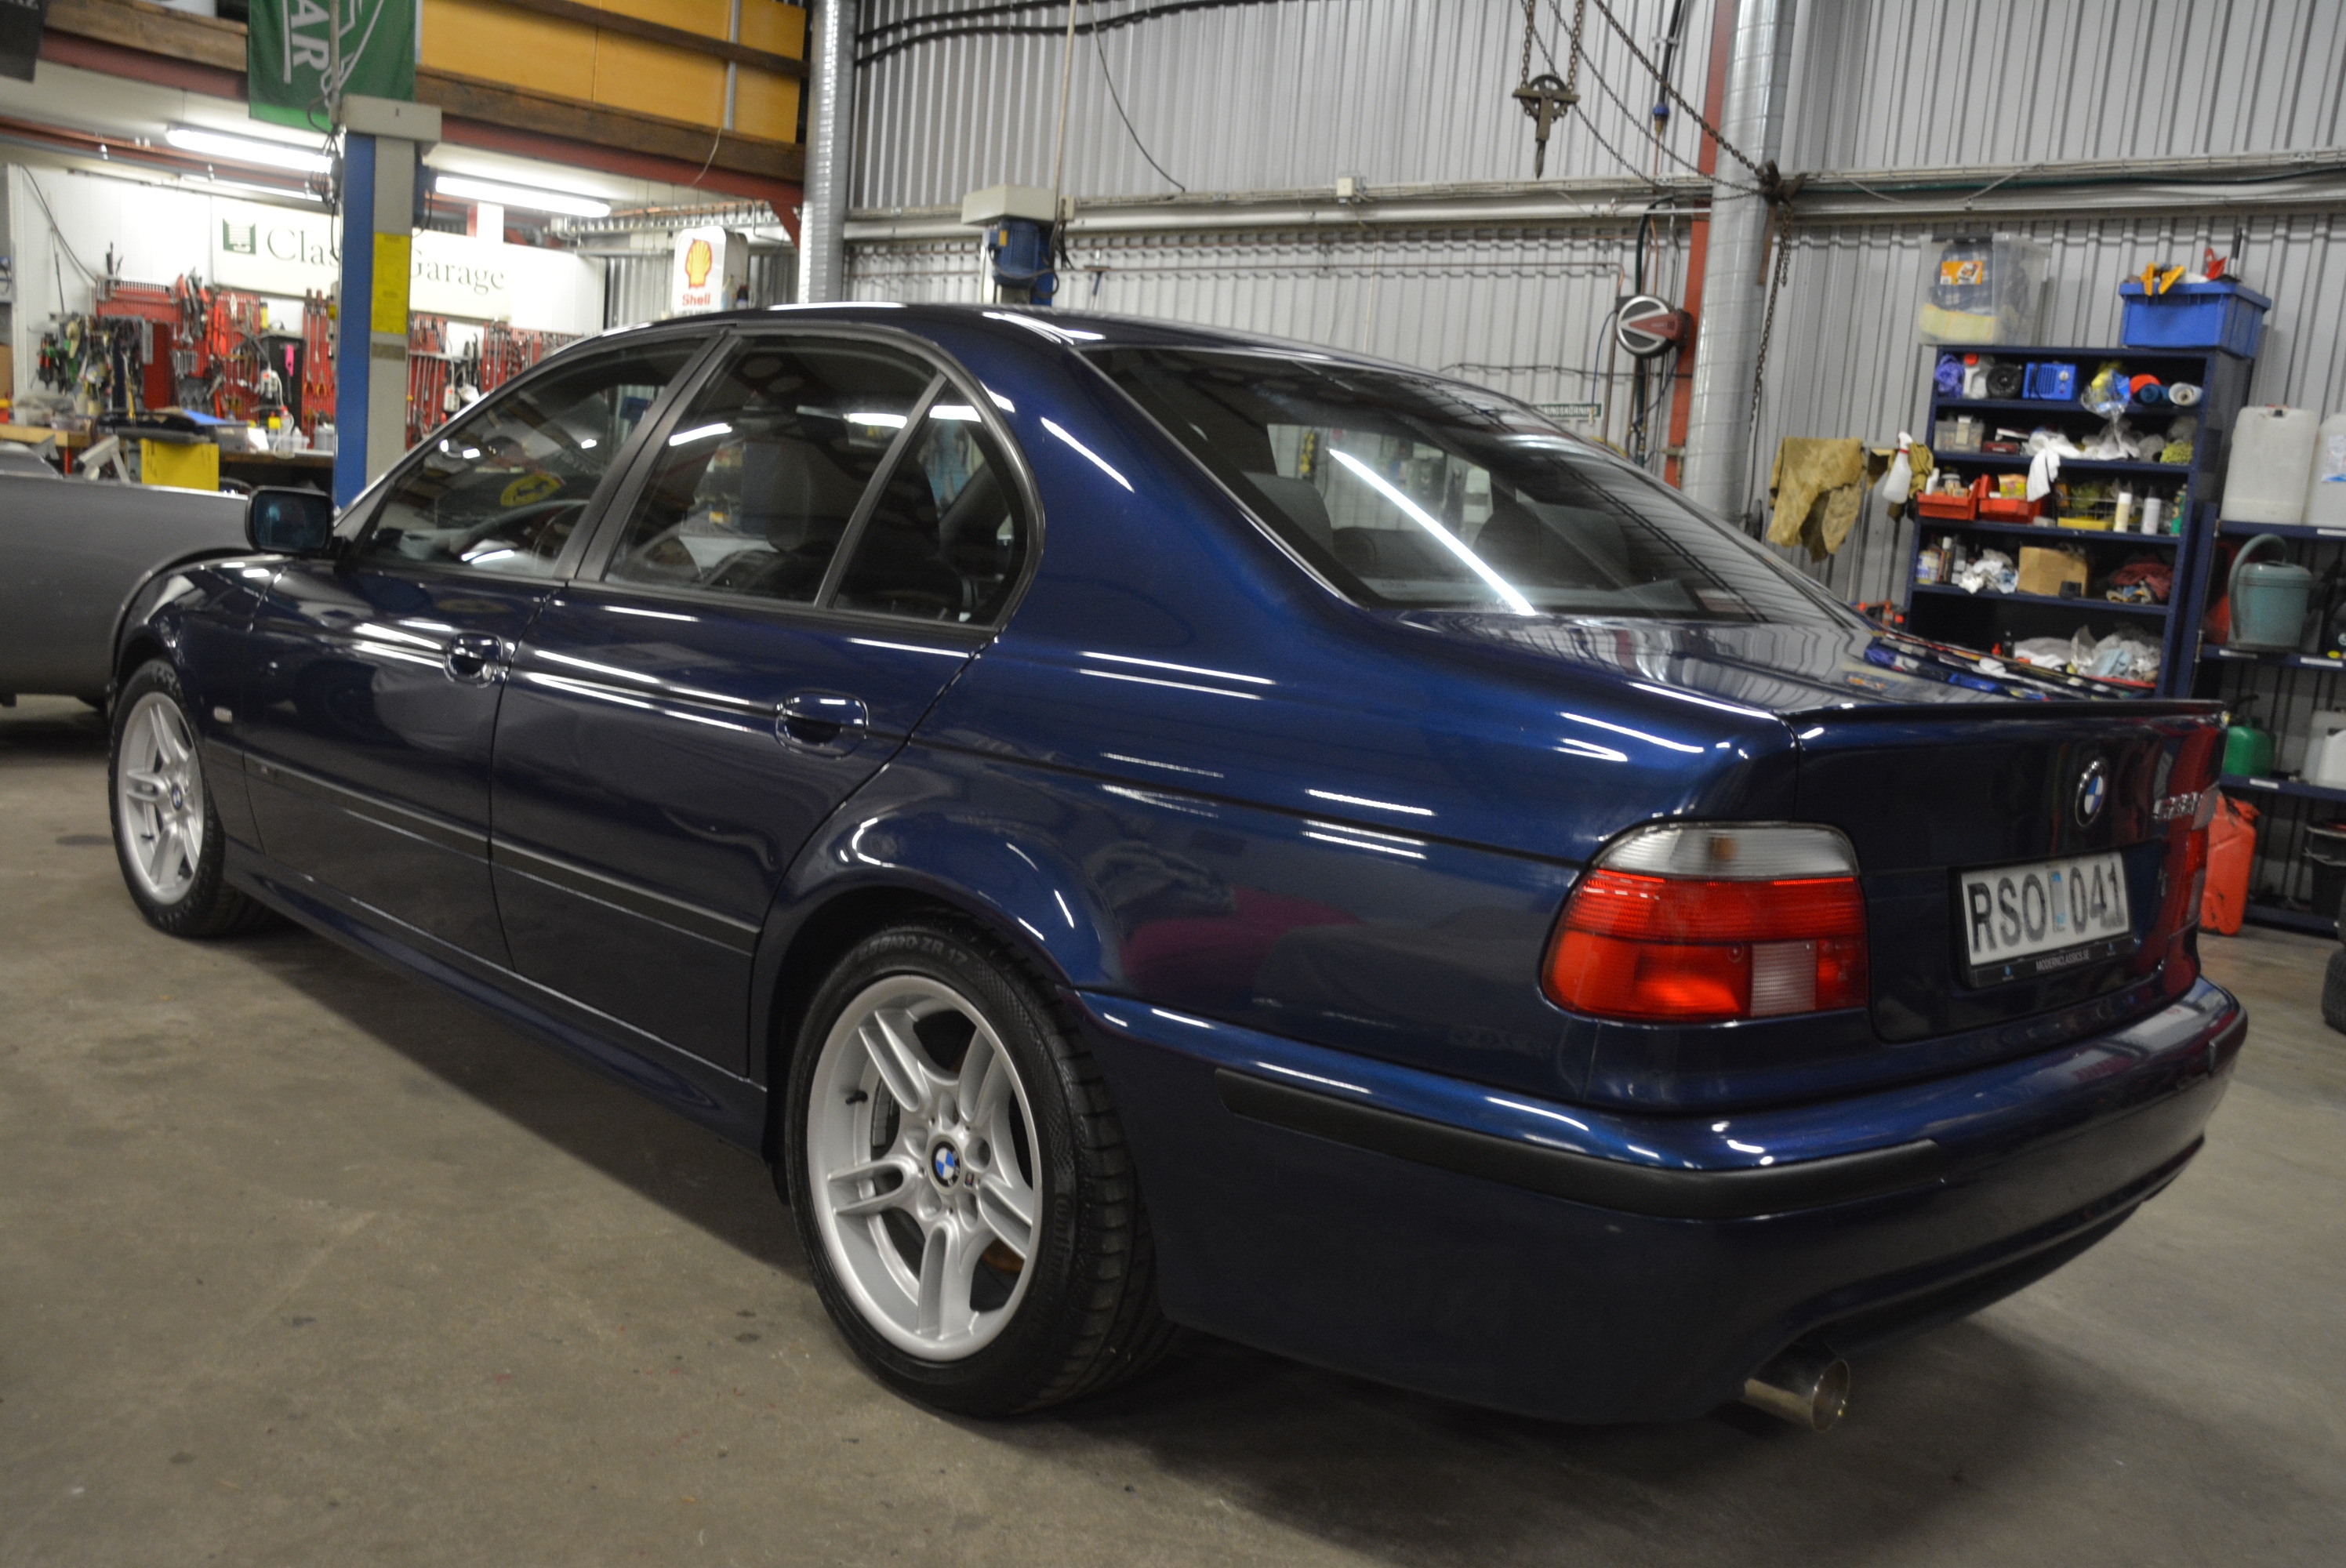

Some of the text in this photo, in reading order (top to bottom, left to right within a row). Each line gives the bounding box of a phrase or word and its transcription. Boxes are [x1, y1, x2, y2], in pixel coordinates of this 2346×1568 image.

[682, 292, 711, 307] Shell
[1967, 862, 2126, 954] RSO 041
